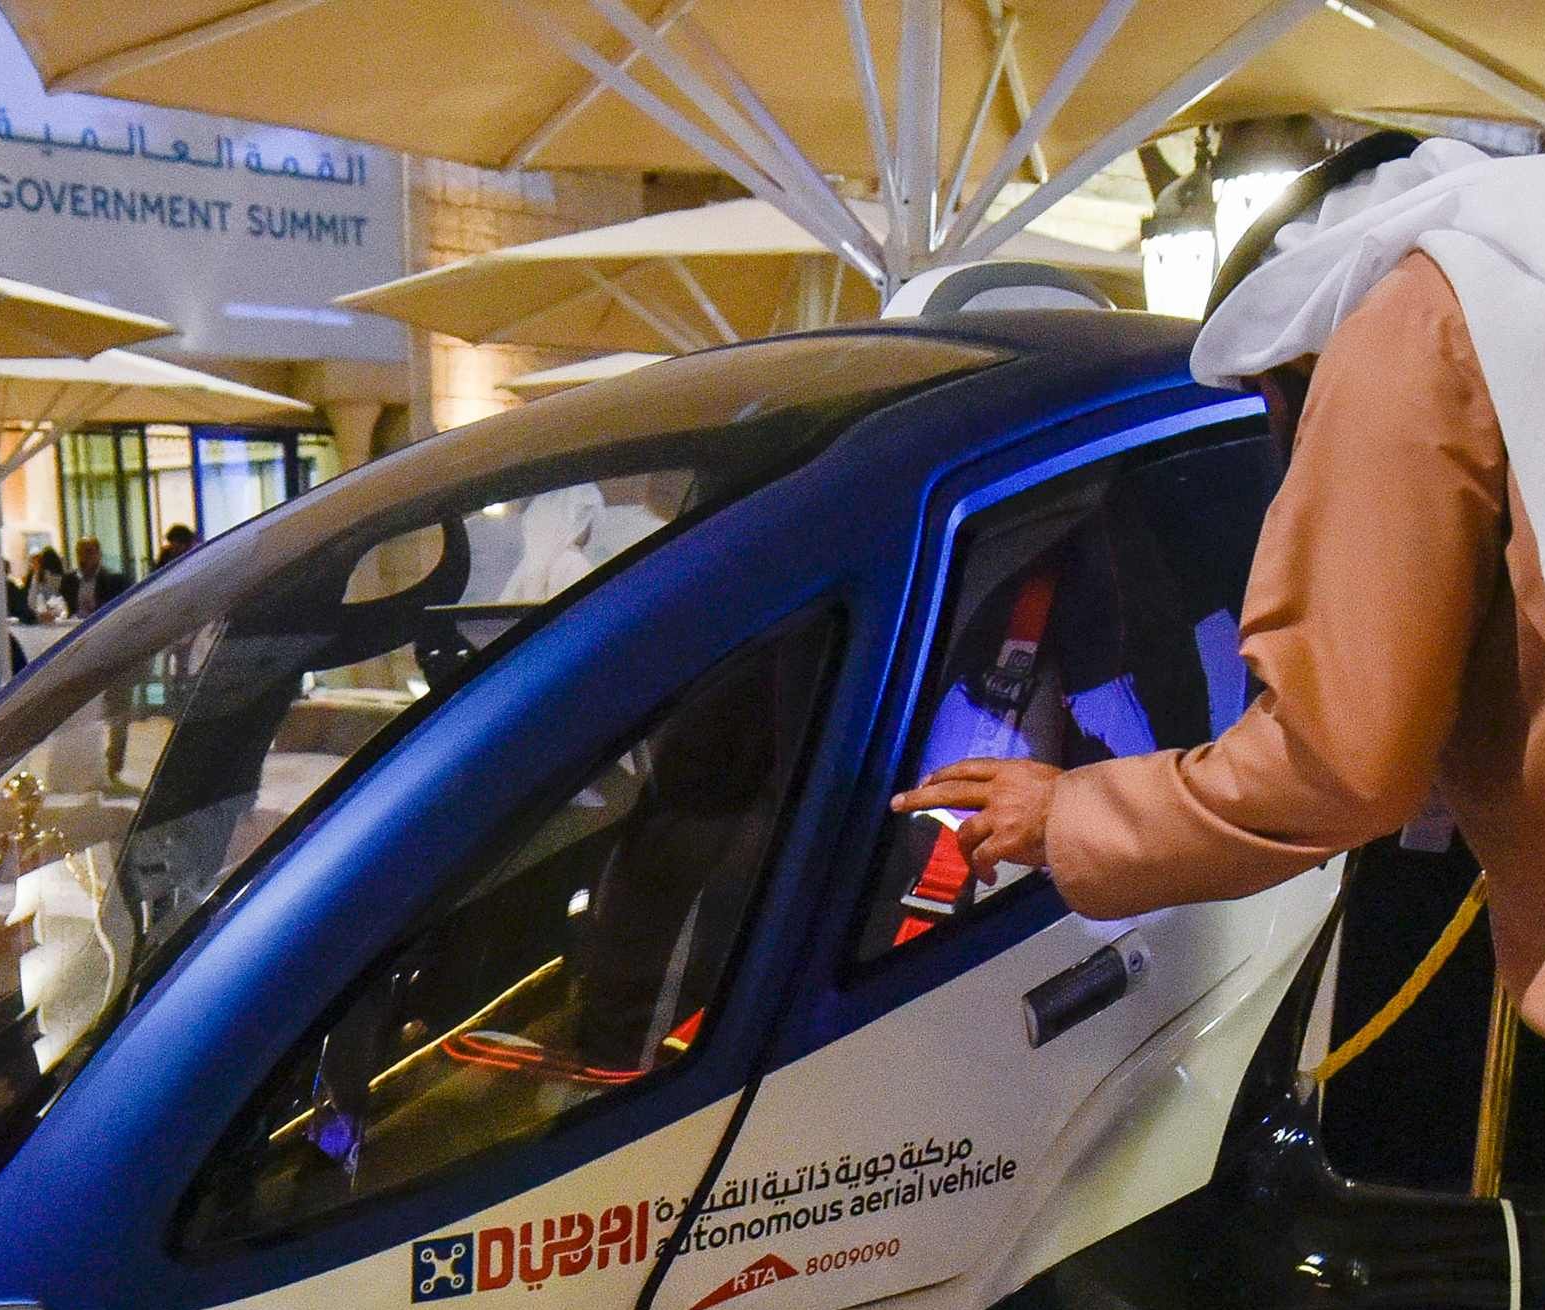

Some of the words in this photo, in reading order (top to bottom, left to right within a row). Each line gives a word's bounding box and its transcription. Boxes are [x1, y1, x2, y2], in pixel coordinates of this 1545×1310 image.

[245, 142, 366, 185] القمة
[247, 203, 367, 246] SUMMIT
[835, 1153, 895, 1190] جوية
[899, 1137, 973, 1175] مركبة
[761, 1161, 830, 1206] ذاتية
[850, 1172, 925, 1217] aerial
[929, 1154, 1017, 1198] vehicle
[476, 1200, 650, 1292] DUBAI
[732, 1266, 779, 1292] RTA
[805, 1238, 901, 1276] 8009090
